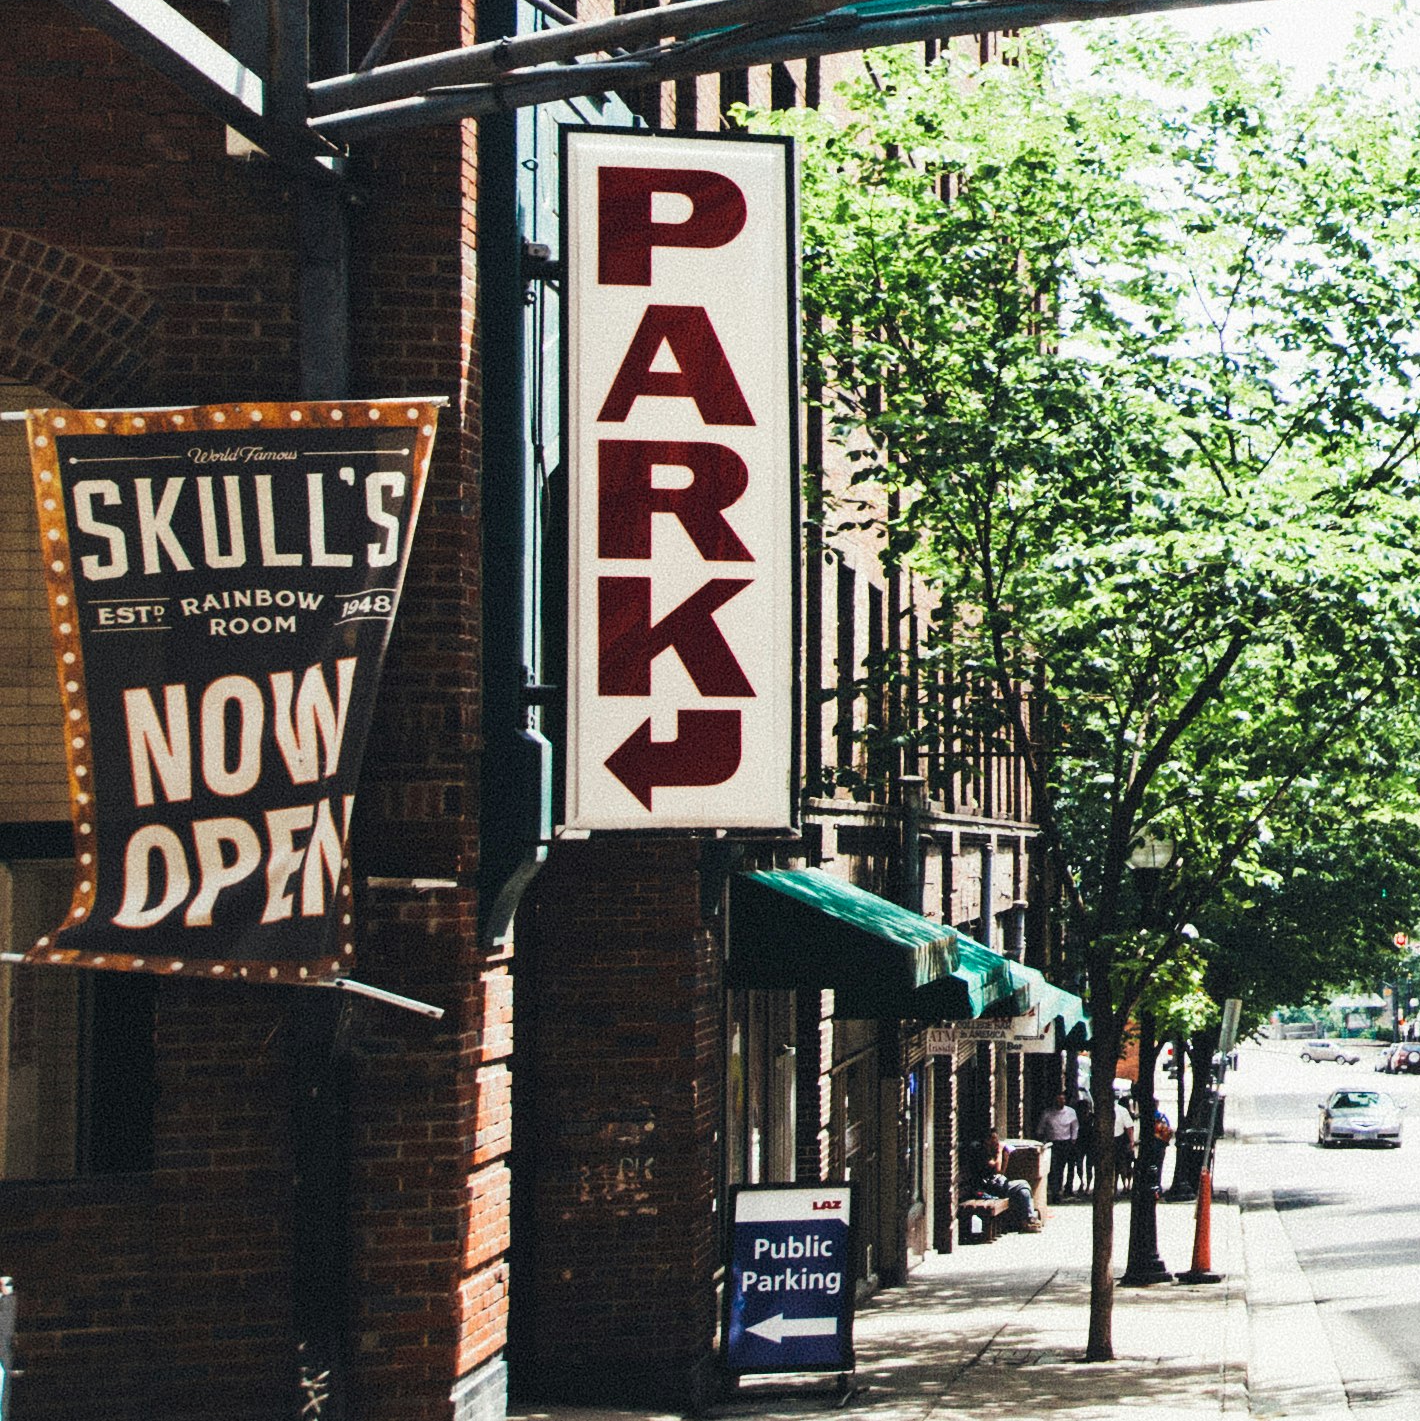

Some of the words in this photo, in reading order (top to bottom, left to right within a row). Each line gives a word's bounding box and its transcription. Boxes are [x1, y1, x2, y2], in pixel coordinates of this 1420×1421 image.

[596, 166, 757, 698] PARK
[187, 447, 238, 464] World
[239, 446, 298, 462] Famous
[72, 466, 406, 581] SKULL'S
[180, 589, 325, 617] RAINBOW
[341, 594, 391, 618] 1948
[209, 615, 297, 637] ROOM
[123, 656, 358, 808] NOW
[111, 794, 355, 929] OPEN
[928, 1030, 956, 1043] ATM
[812, 1200, 842, 1211] LAZ
[754, 1234, 833, 1260] Public
[741, 1268, 842, 1295] Parking
